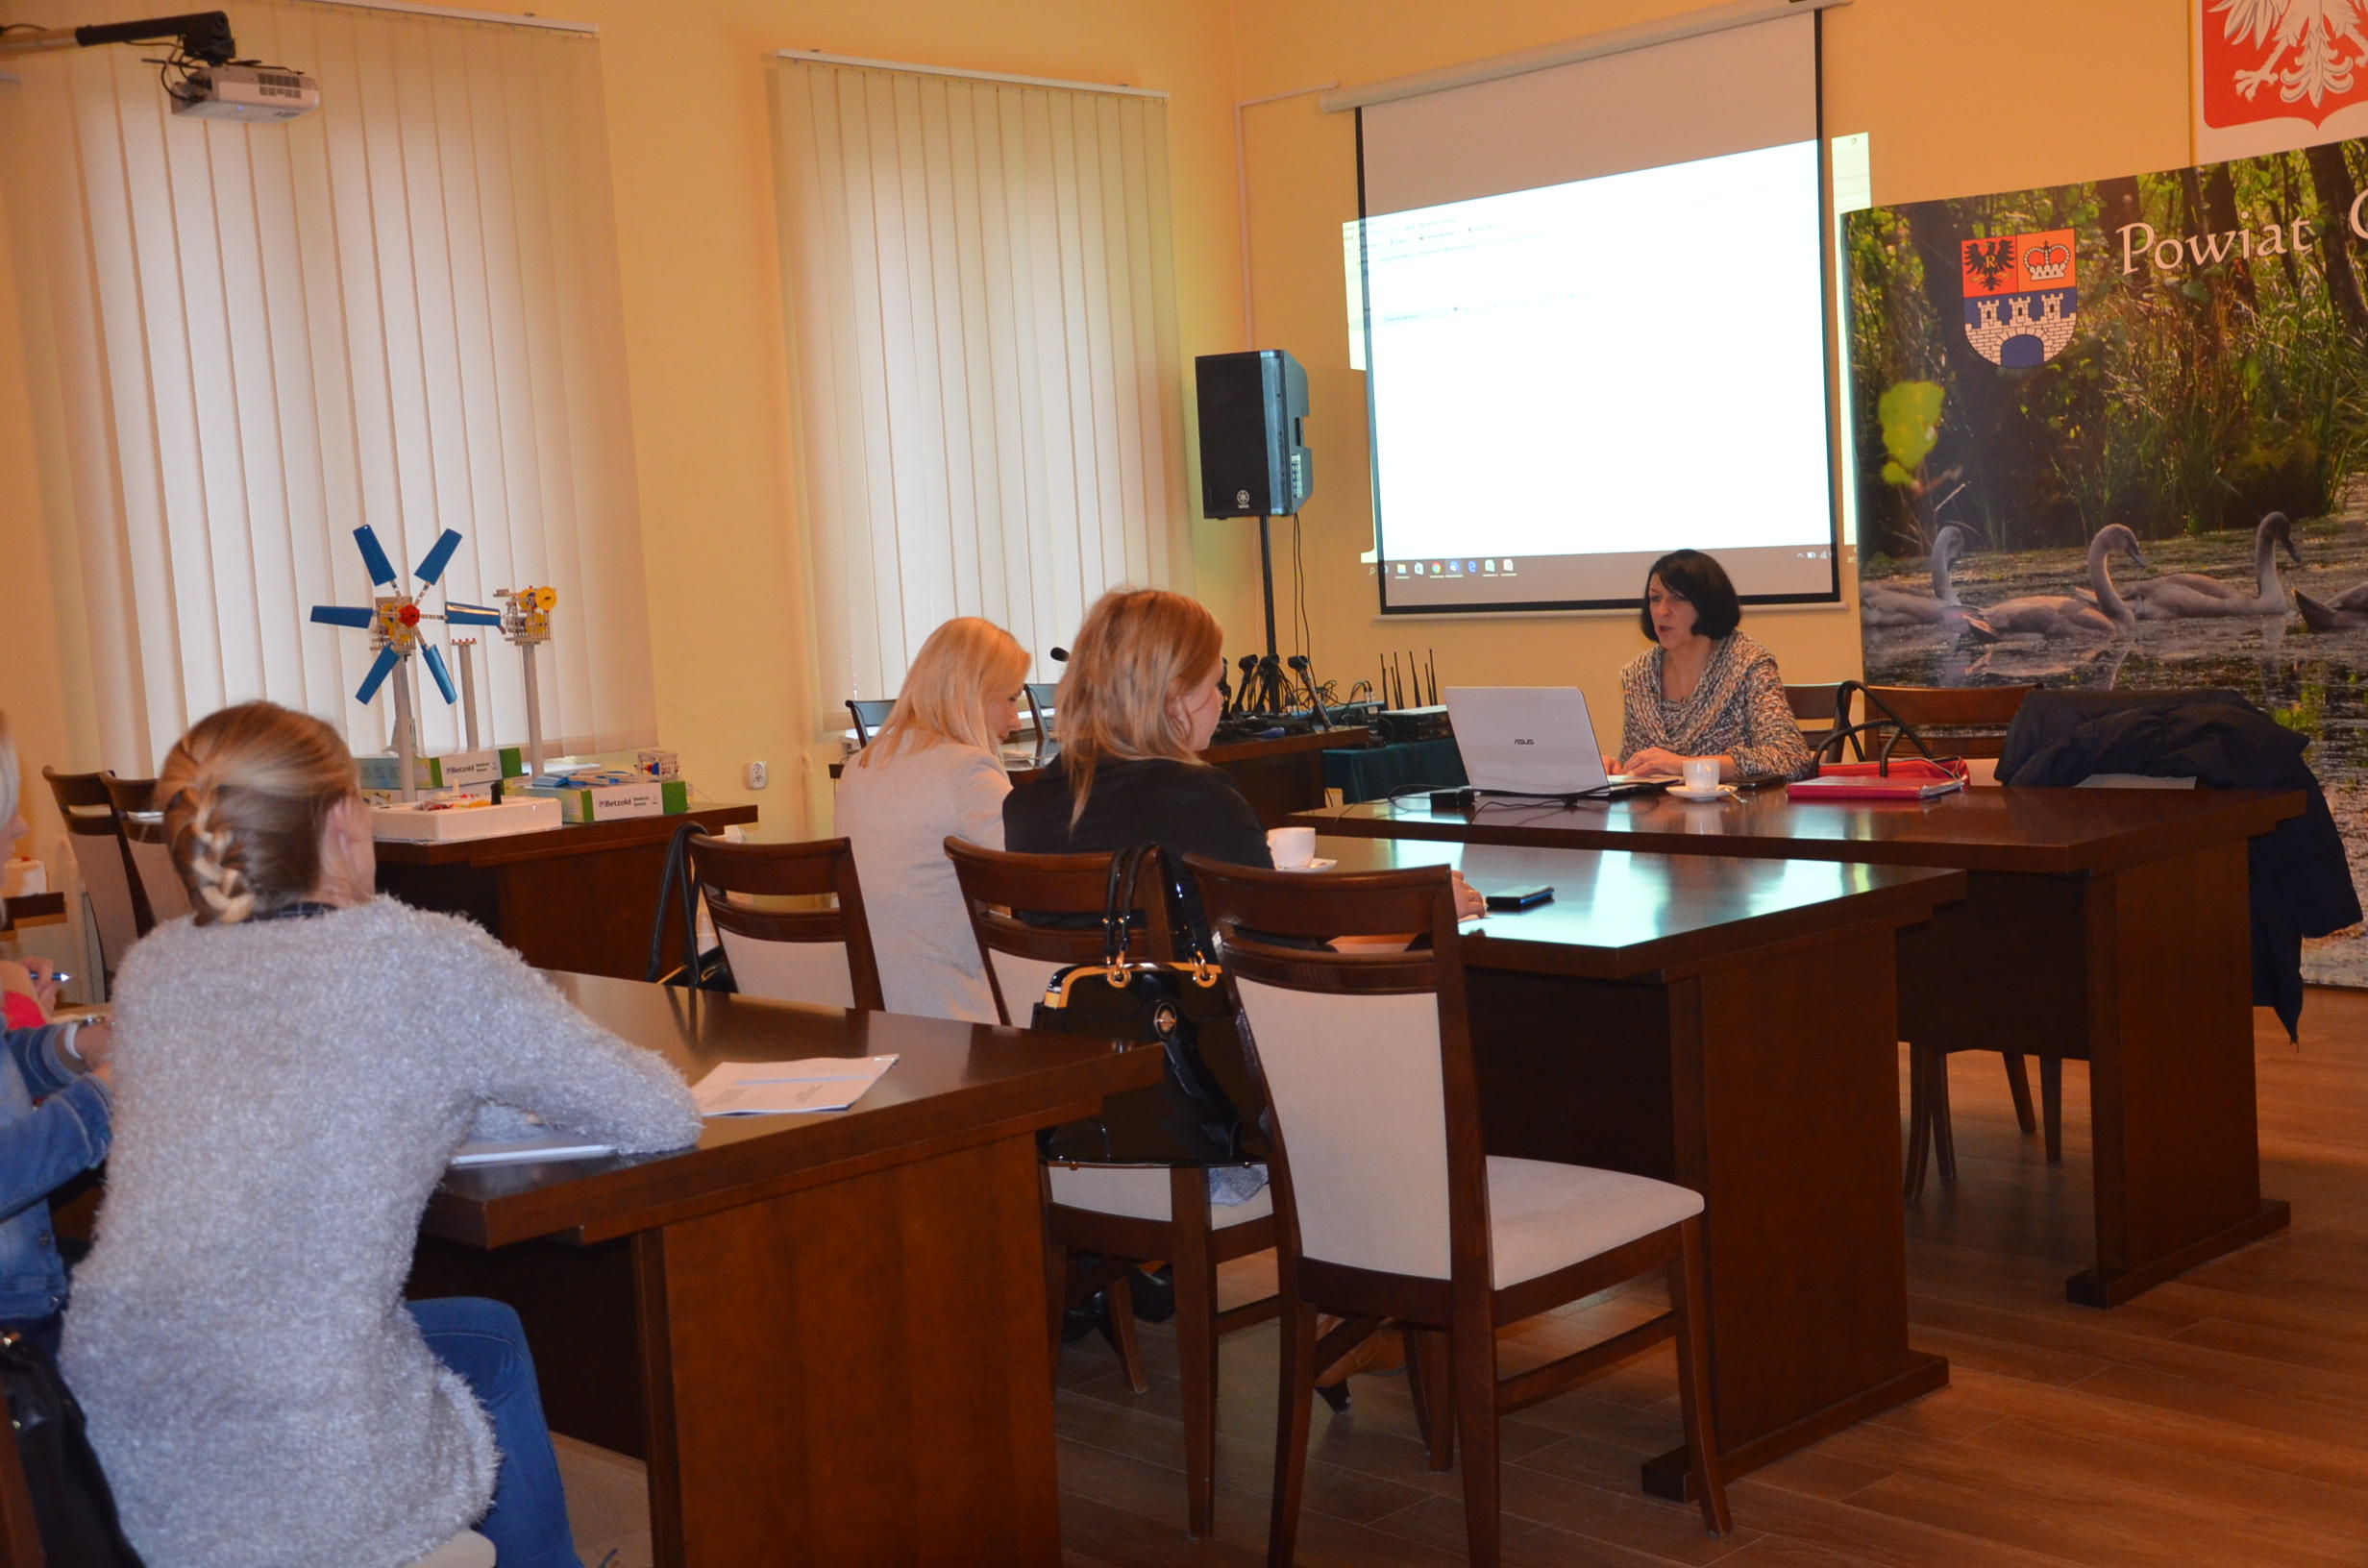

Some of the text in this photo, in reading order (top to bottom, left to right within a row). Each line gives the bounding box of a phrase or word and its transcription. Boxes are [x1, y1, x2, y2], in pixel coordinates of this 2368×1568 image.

[2115, 211, 2312, 276] Powiat
[1985, 255, 1997, 268] R
[452, 764, 475, 774] Betzold
[604, 797, 631, 808] Betzold
